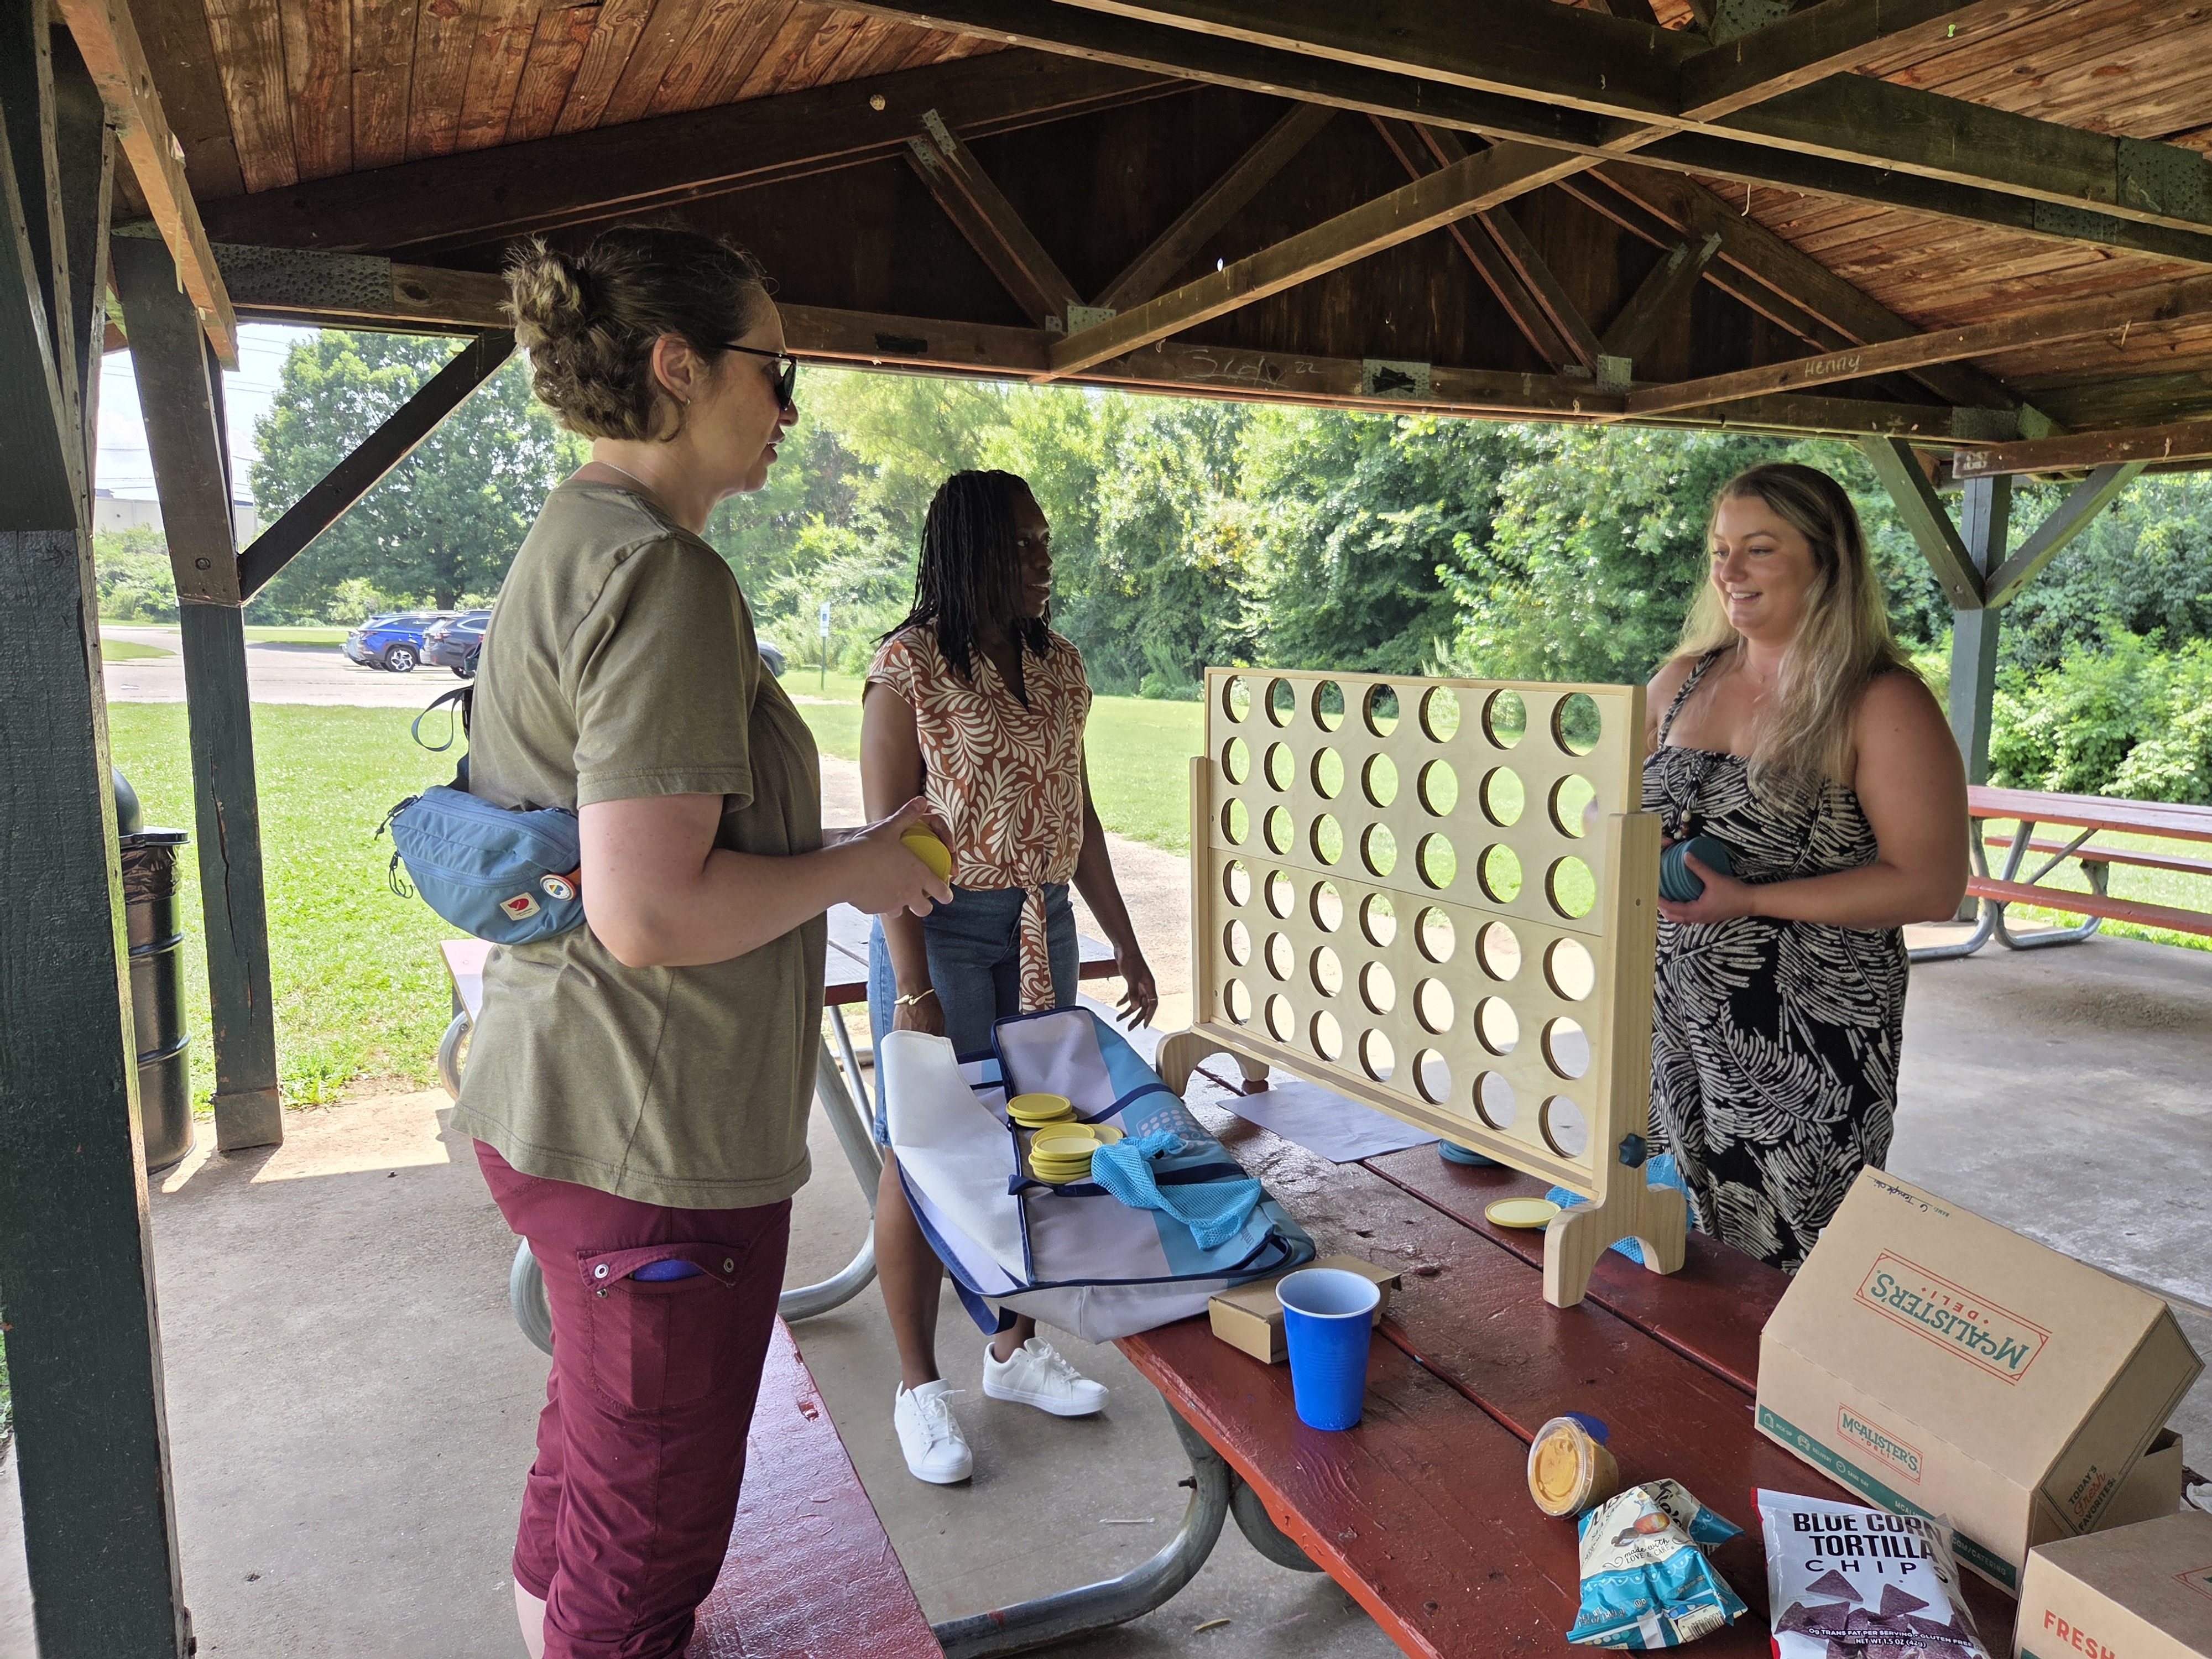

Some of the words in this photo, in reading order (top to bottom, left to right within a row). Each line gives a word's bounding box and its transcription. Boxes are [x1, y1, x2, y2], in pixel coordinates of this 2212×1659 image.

[1804, 354, 1860, 378] Henny
[1930, 1291, 1979, 1321] DELI
[1776, 1423, 1792, 1436] PICK-UP
[1813, 1447, 1832, 1463] DELIVERY
[1848, 1470, 1859, 1481] SAME
[1860, 1479, 1869, 1488] DAY
[1866, 1440, 1890, 1460] DELI
[2069, 1465, 2097, 1504] TODAY'S
[2074, 1473, 2106, 1517] Fresh
[1793, 1512, 1858, 1532] BLUE
[1866, 1513, 1943, 1542] CORN
[1625, 1546, 1646, 1558] made
[1648, 1538, 1670, 1550] with
[1626, 1552, 1645, 1564] LOVE
[1809, 1535, 1939, 1564] TORTILLA
[1805, 1559, 1948, 1584] CHIPS
[1879, 1630, 1913, 1638] SERVING
[1920, 1634, 1952, 1644] GLUTEN
[1953, 1639, 1974, 1648] FREE
[1906, 1639, 1927, 1648] (42g)
[2044, 1609, 2115, 1659] FRESH
